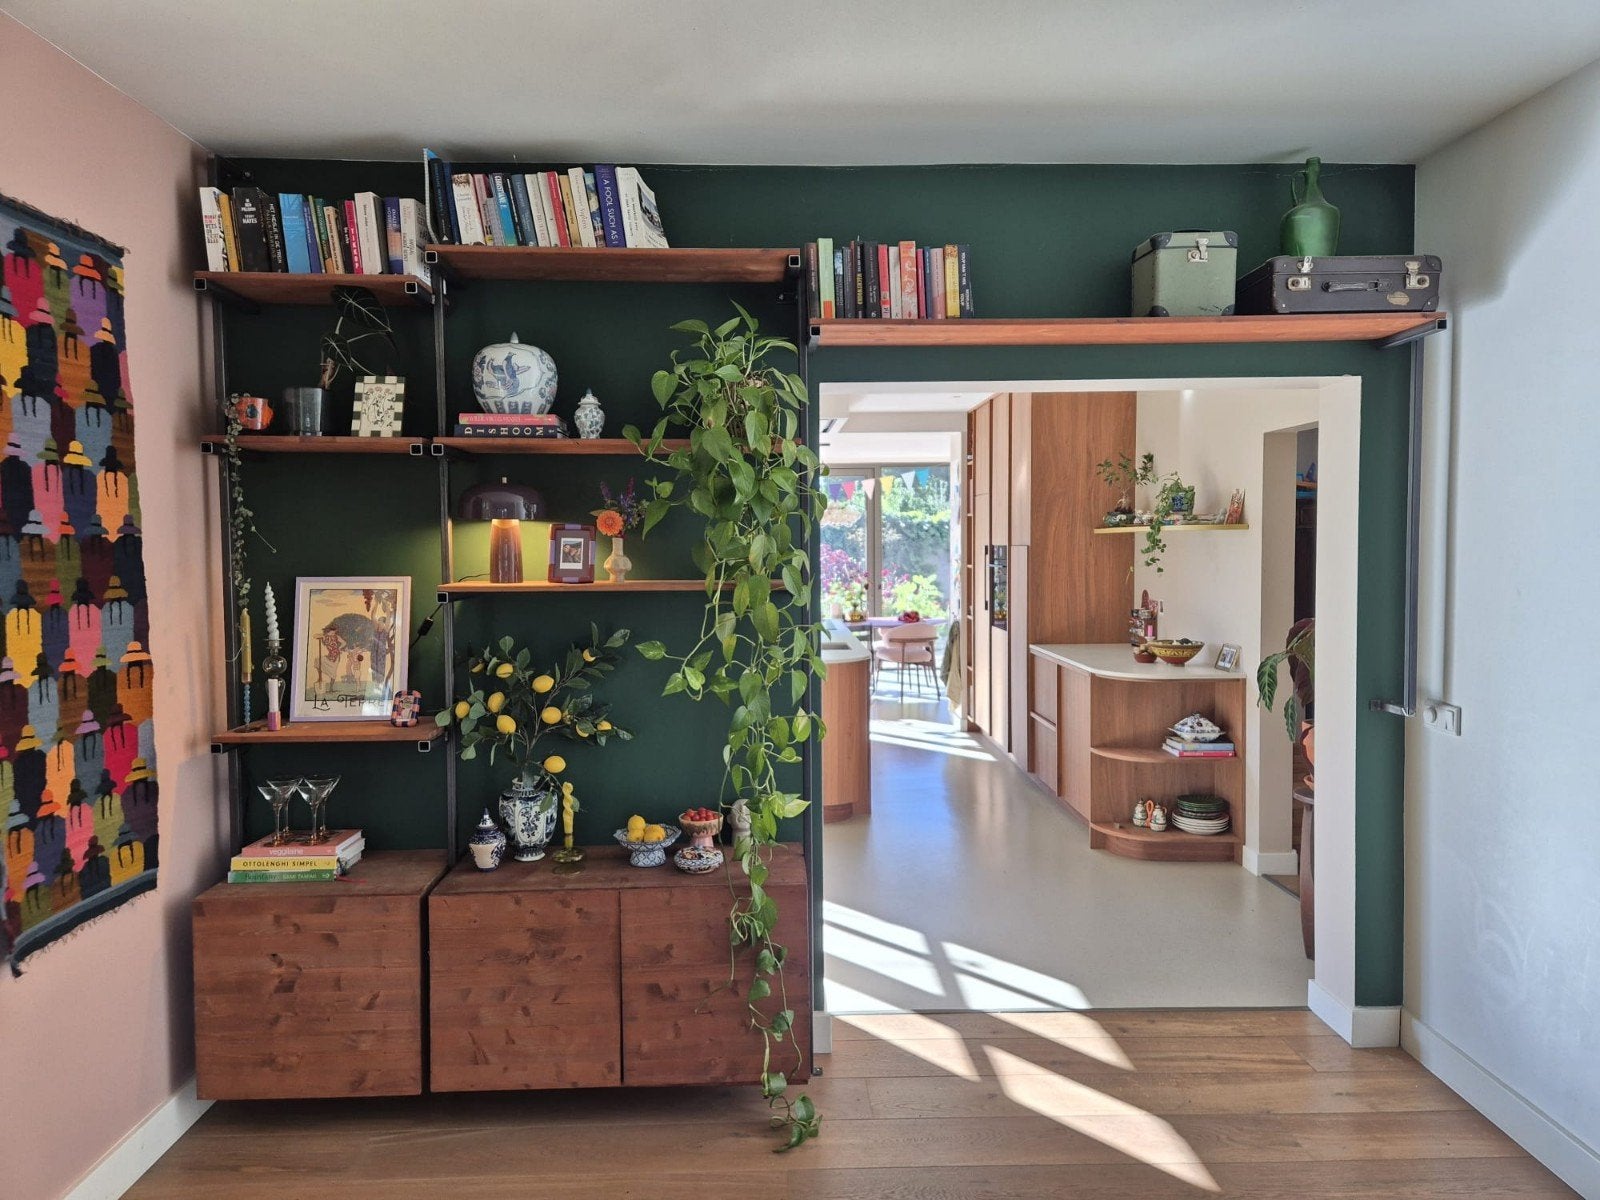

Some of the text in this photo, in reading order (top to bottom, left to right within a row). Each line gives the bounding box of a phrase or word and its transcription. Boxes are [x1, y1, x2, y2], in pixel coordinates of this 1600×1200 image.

[605, 186, 613, 206] FOOL
[608, 208, 616, 228] SUCH
[611, 229, 618, 240] AS
[464, 427, 544, 435] DISHOOM
[312, 694, 330, 711] LA
